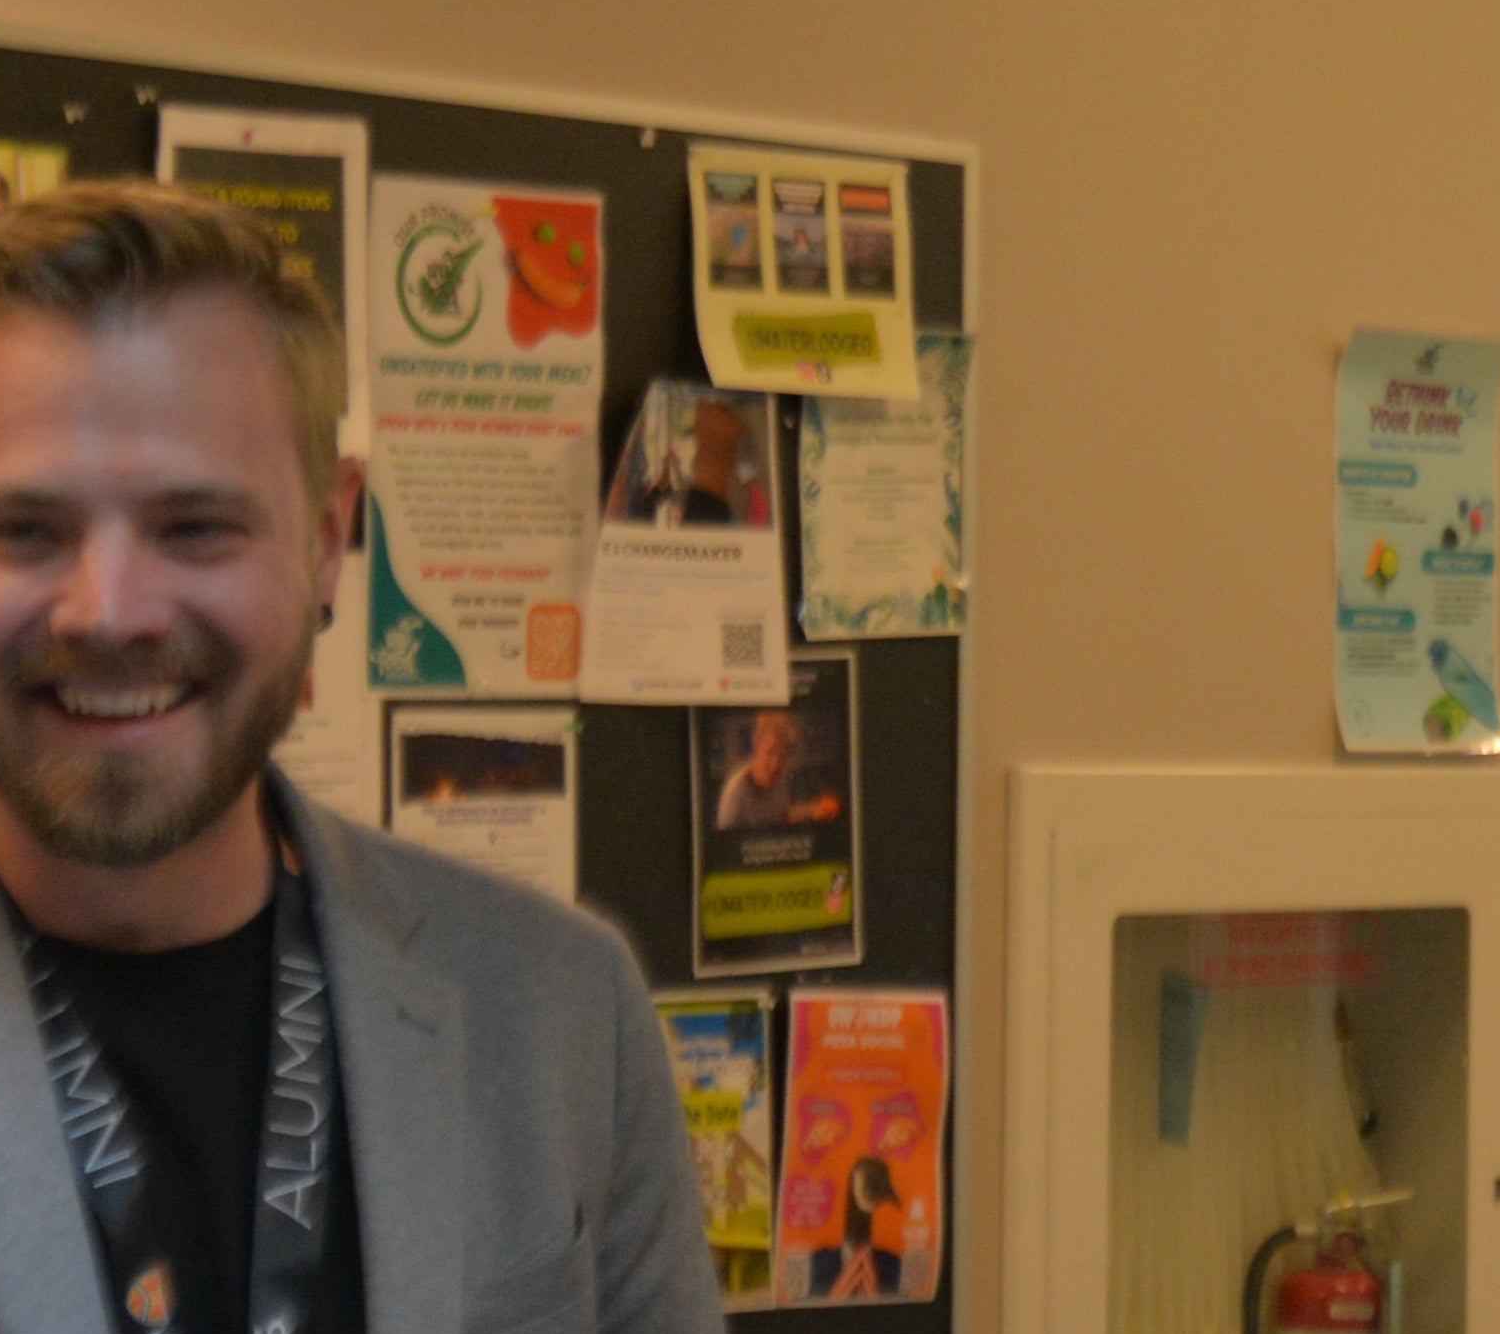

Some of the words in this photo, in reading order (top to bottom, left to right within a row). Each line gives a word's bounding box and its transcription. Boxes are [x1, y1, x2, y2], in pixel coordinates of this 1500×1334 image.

[394, 211, 420, 247] OUR
[379, 357, 467, 381] UNSATISFIED
[473, 361, 504, 381] WITH
[509, 362, 544, 383] YOUR
[1384, 379, 1454, 411] RETHINK
[1369, 407, 1412, 436] YOUR
[1415, 411, 1463, 439] DRINK
[622, 543, 743, 564] CHANGEMAKER
[262, 953, 327, 1232] ALUMNI
